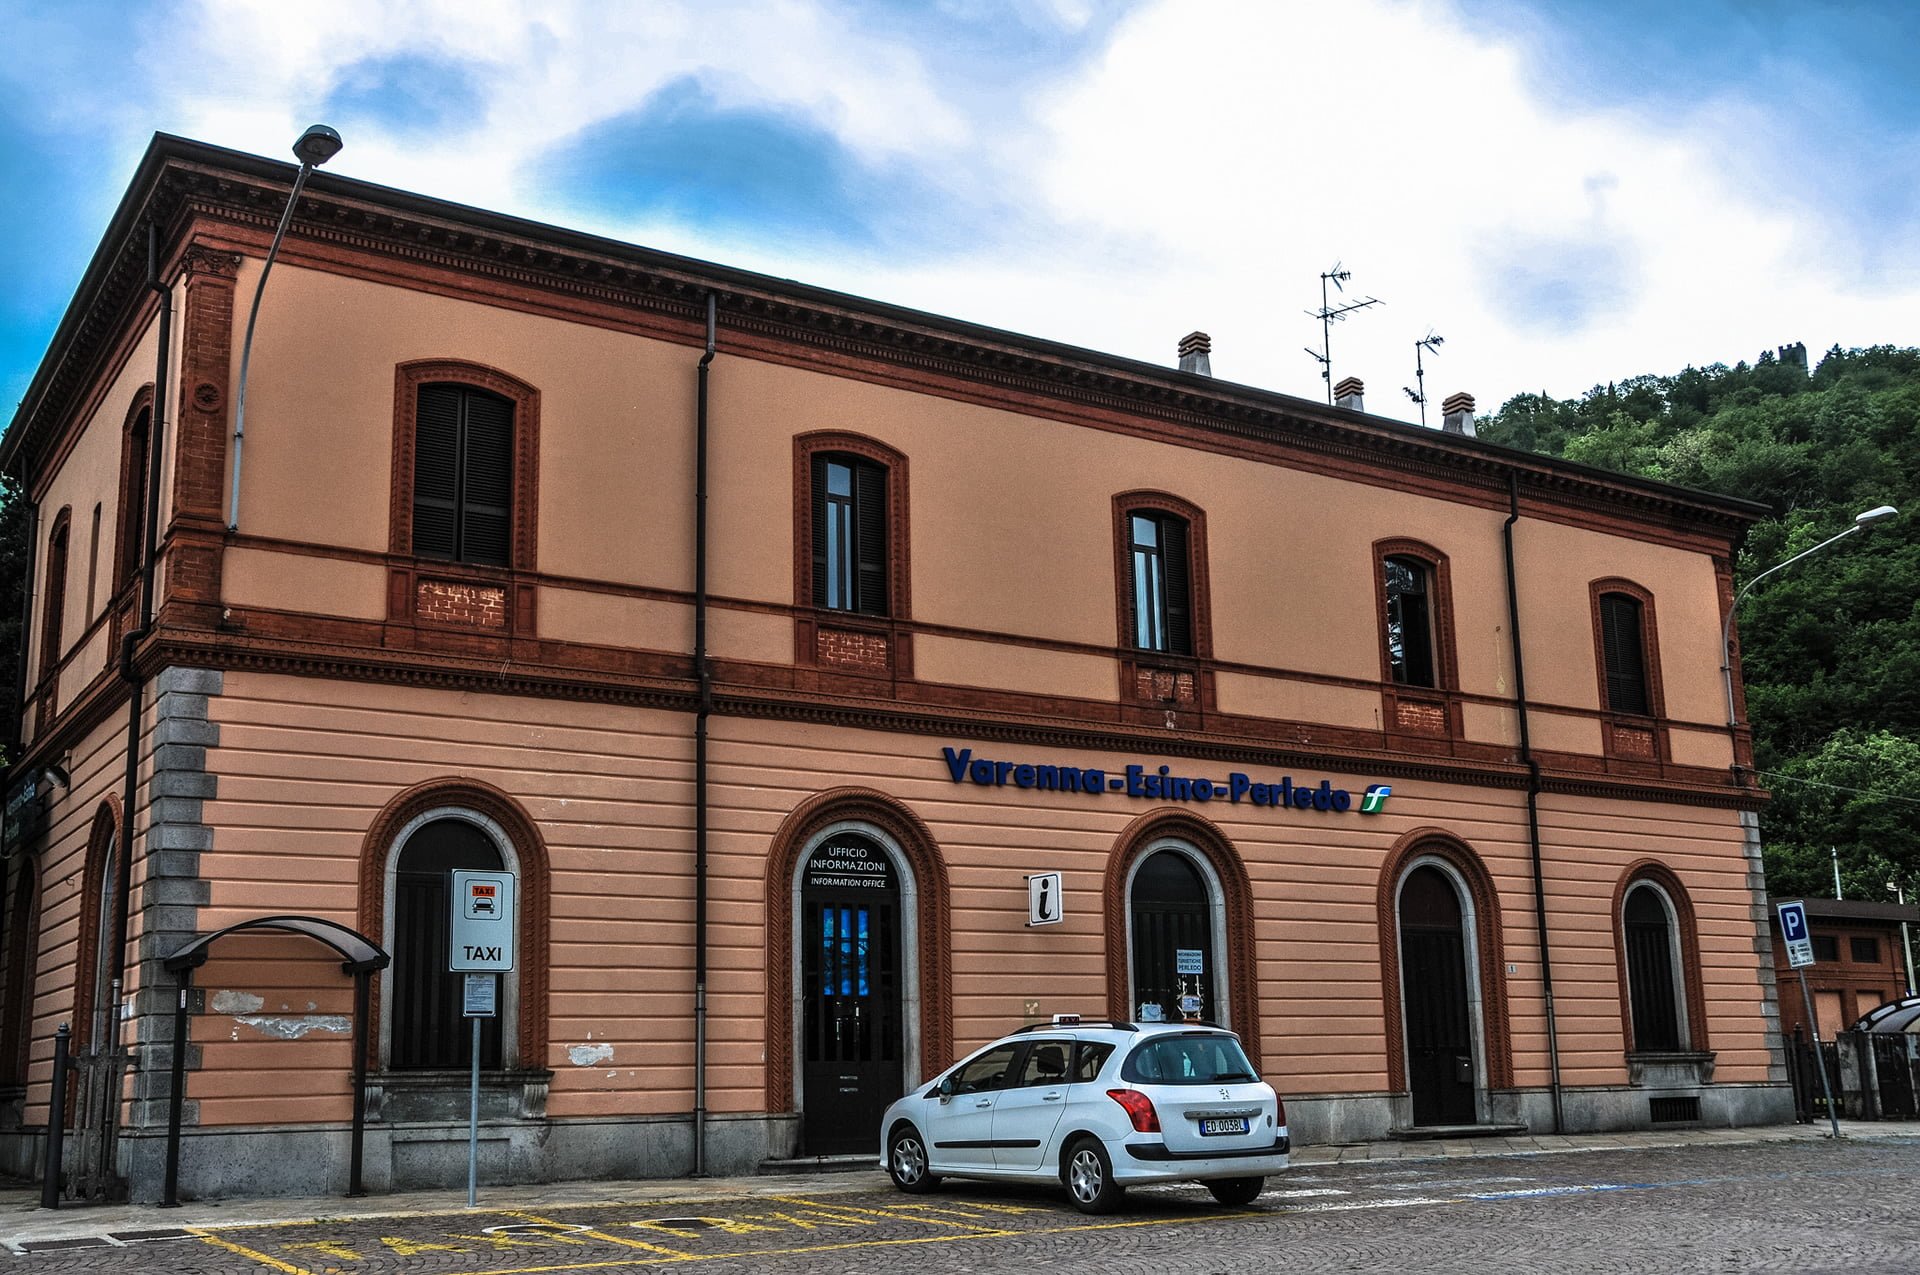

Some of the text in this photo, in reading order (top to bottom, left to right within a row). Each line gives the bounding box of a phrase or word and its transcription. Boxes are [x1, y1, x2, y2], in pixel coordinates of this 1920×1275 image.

[942, 747, 1351, 812] Varenna-Esino-Perledo
[828, 847, 868, 858] UFFICIO
[810, 859, 886, 872] INFORMAZIONI
[811, 877, 886, 888] INFORMATION OFFICE
[474, 887, 494, 895] TAXI
[1785, 911, 1799, 937] P
[463, 946, 502, 961] TAXI
